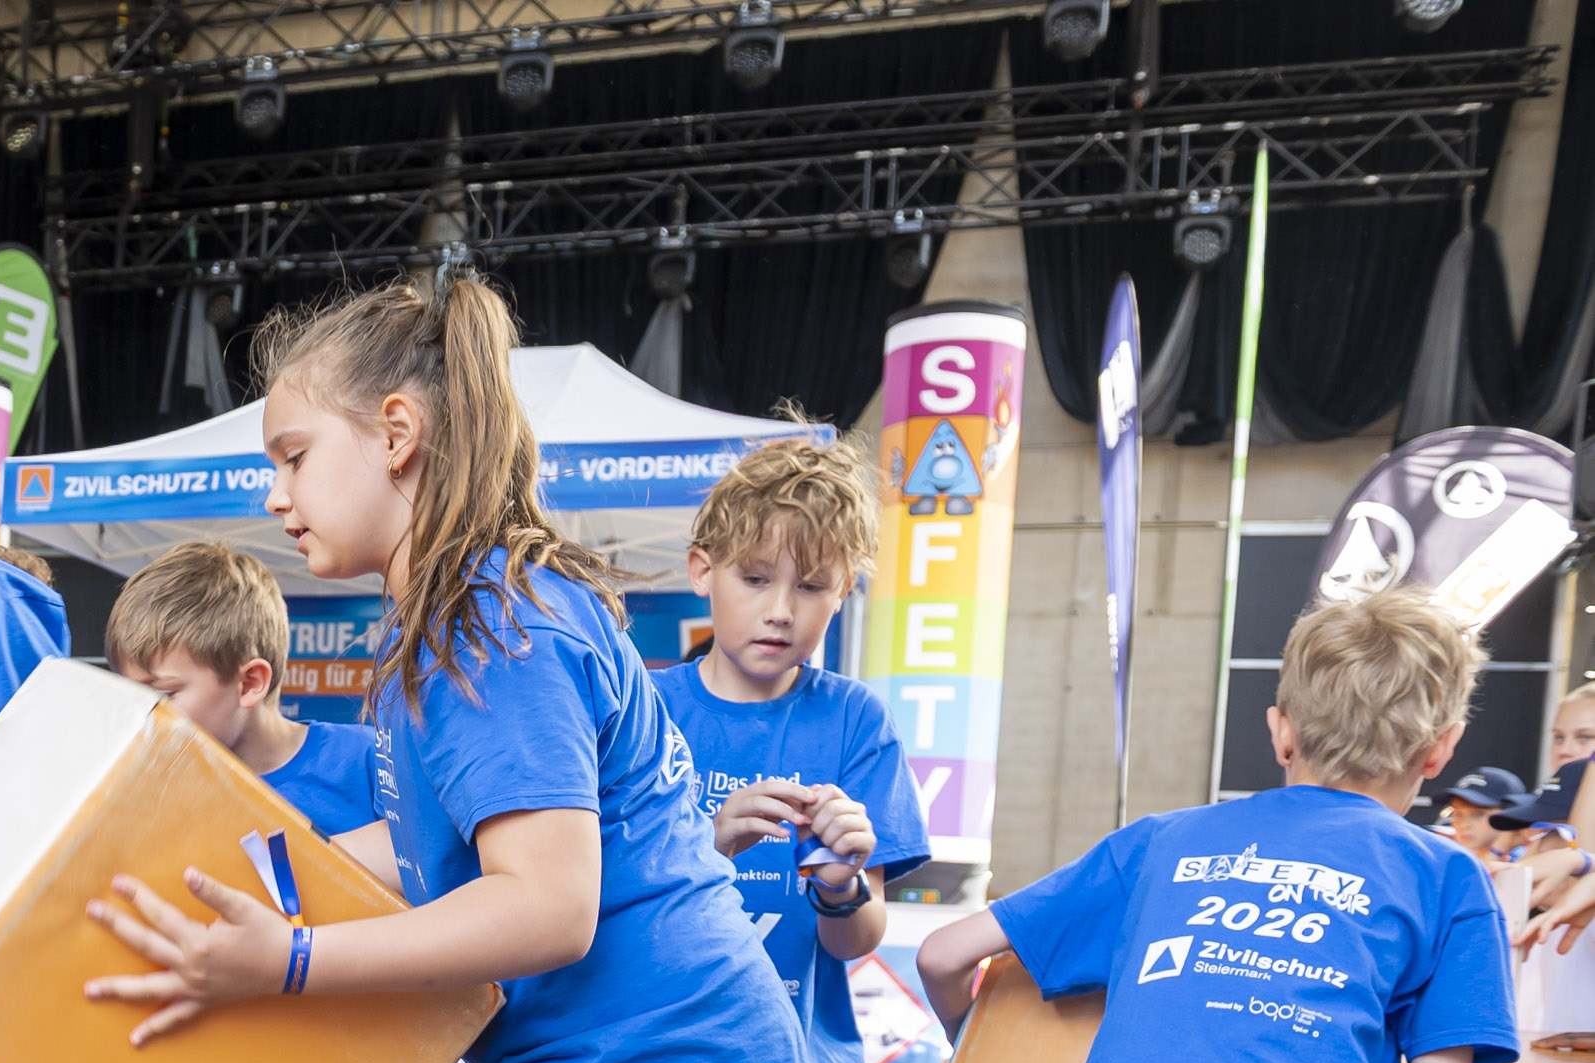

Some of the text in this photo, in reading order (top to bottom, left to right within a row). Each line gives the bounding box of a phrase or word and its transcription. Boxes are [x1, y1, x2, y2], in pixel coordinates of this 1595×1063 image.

[64, 472, 207, 497] ZIVILSCHUTZ
[225, 467, 277, 490] VOR
[326, 663, 356, 686] für
[714, 771, 748, 791] Das
[1268, 884, 1371, 915] ON TOUR
[1186, 895, 1331, 943] 2026
[1193, 960, 1272, 981] Steiermark
[1198, 941, 1349, 988] Zivilschutz
